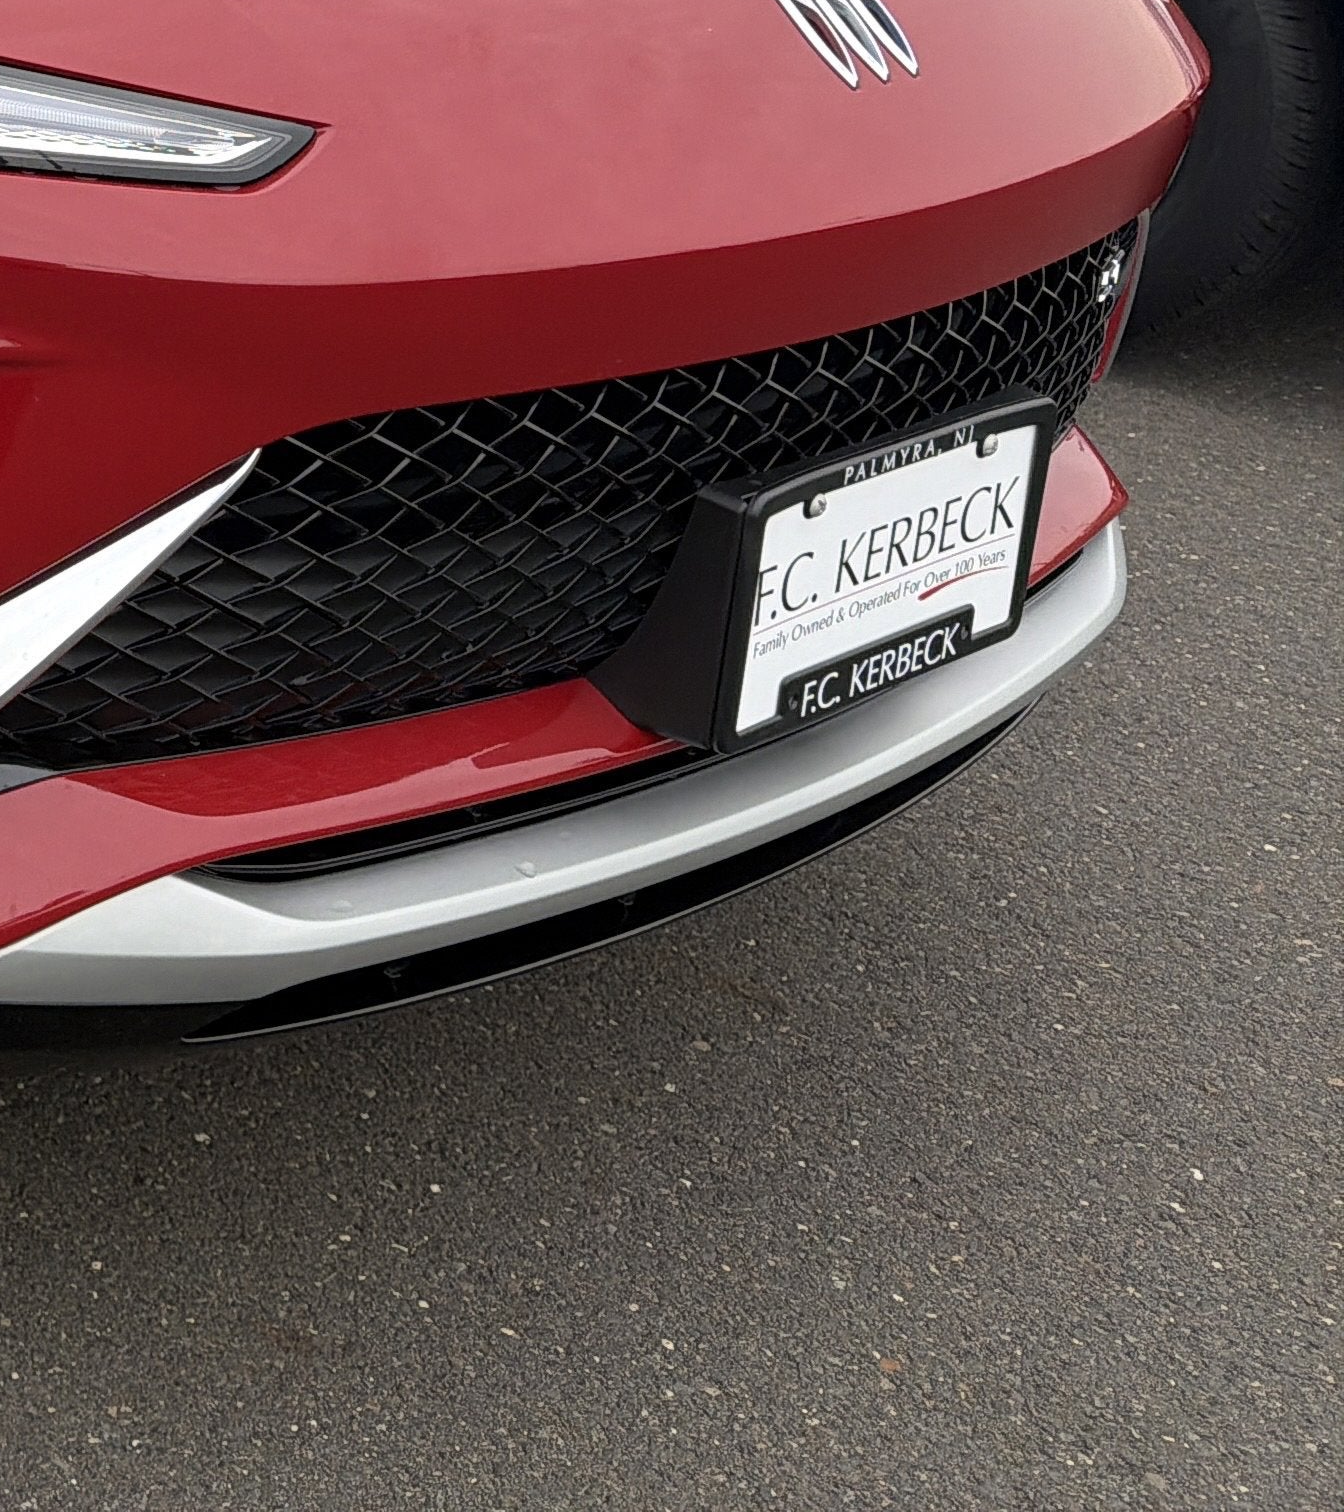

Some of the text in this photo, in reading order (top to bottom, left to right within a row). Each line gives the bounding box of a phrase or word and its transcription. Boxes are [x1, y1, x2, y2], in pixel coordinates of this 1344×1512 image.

[843, 439, 942, 486] PALMYRA,
[753, 475, 1021, 627] F.C. KERBECK
[752, 548, 1007, 660] Family Owned & Operated For Over 100 Years
[800, 622, 961, 718] F.C. KERBECK
